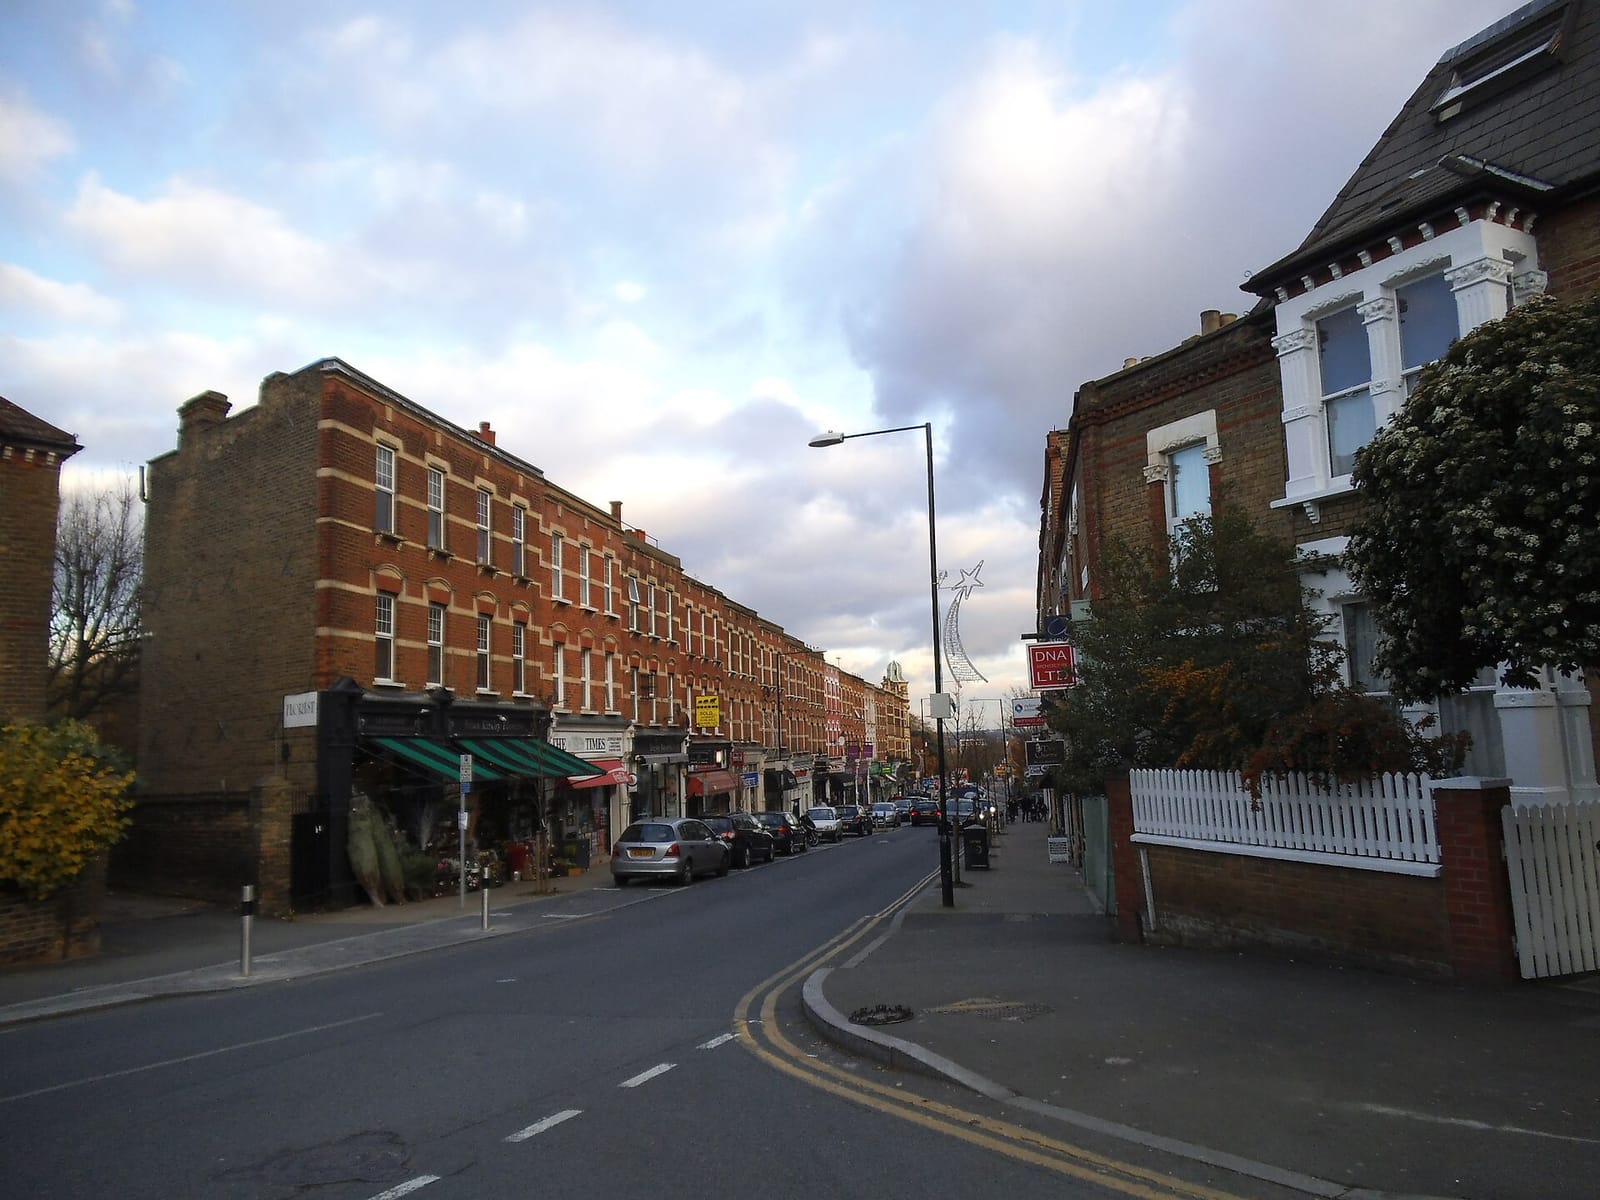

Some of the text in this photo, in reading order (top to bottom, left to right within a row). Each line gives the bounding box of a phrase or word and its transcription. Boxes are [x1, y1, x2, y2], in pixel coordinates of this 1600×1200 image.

[1035, 650, 1067, 662] DNA
[1037, 670, 1069, 682] LTD
[585, 737, 606, 750] TIMES
